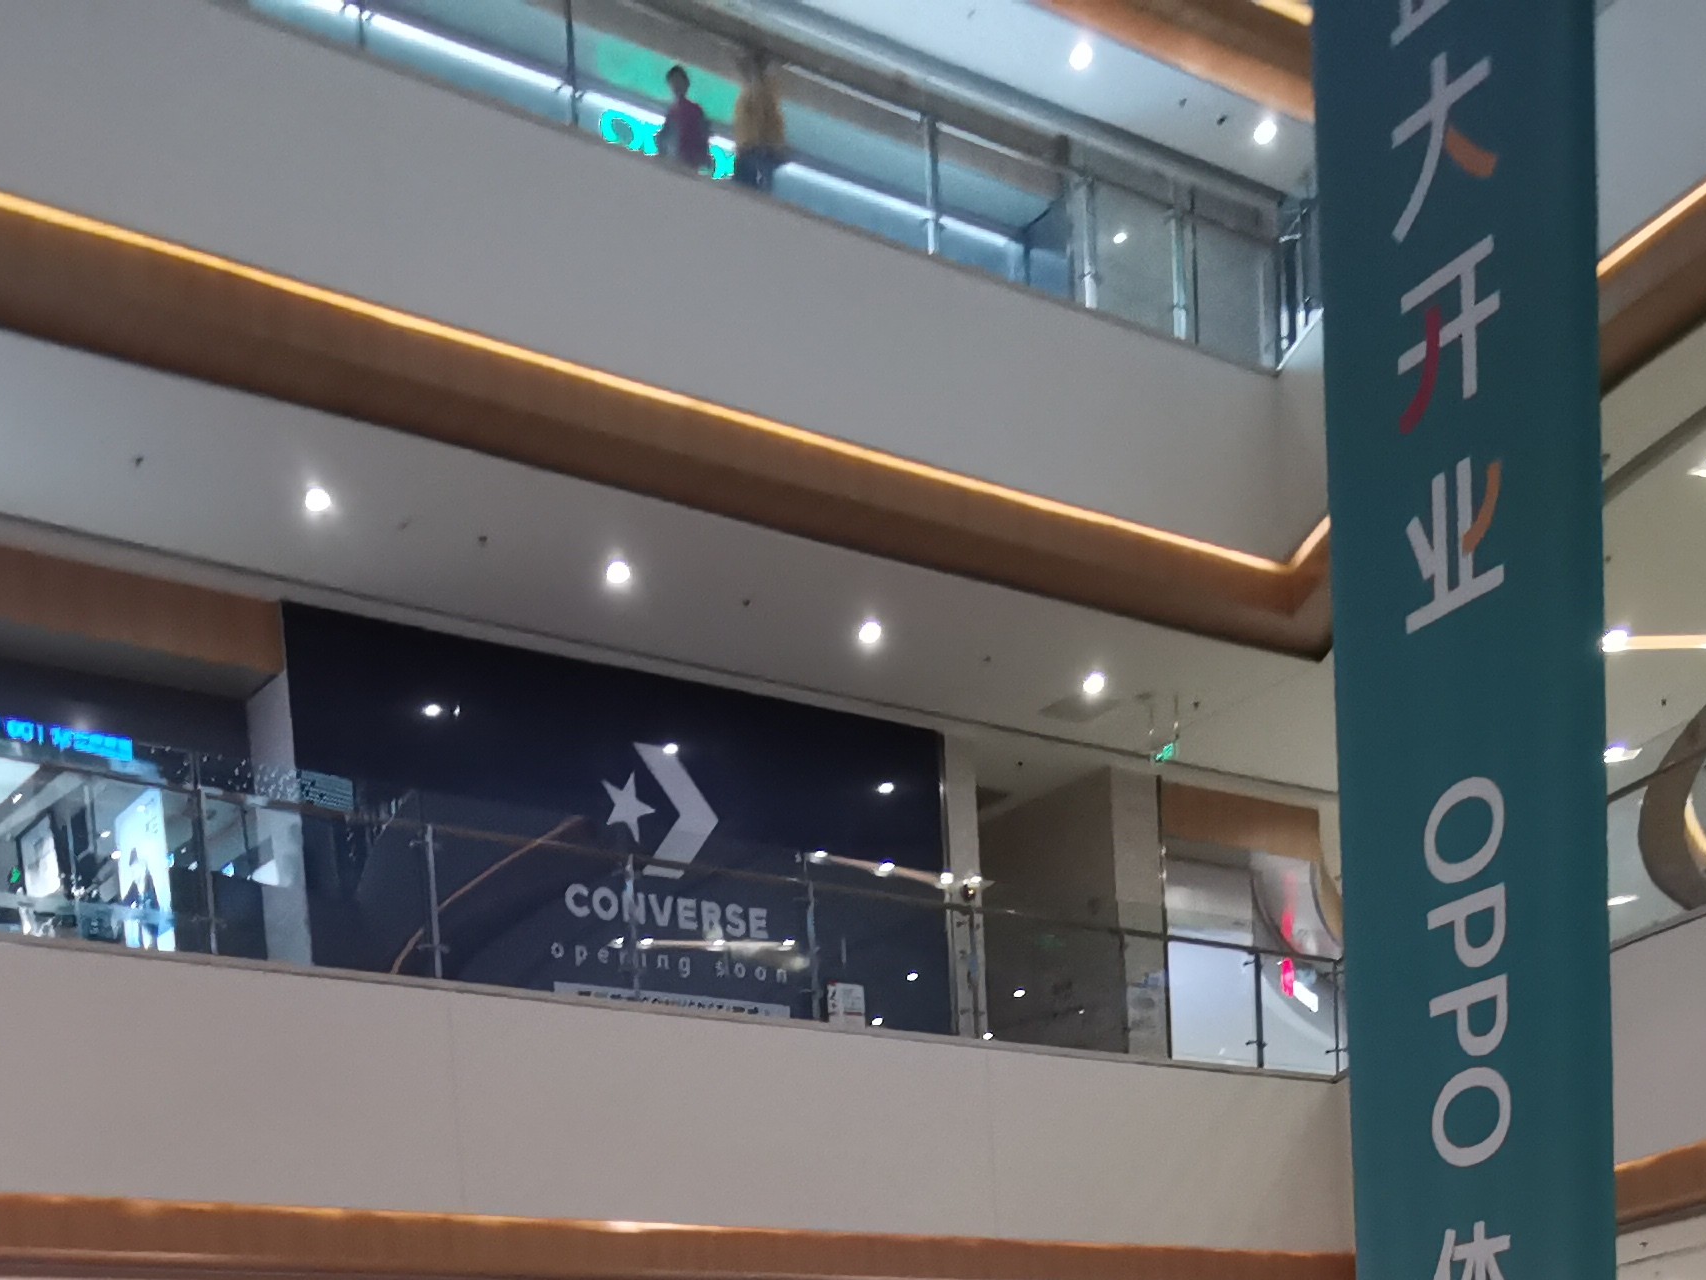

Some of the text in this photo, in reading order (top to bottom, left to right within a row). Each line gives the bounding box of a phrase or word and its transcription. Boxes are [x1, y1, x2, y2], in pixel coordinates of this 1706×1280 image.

[564, 882, 770, 940] CONVERSE
[550, 940, 789, 984] opening soon
[1422, 774, 1512, 1169] OPPO
